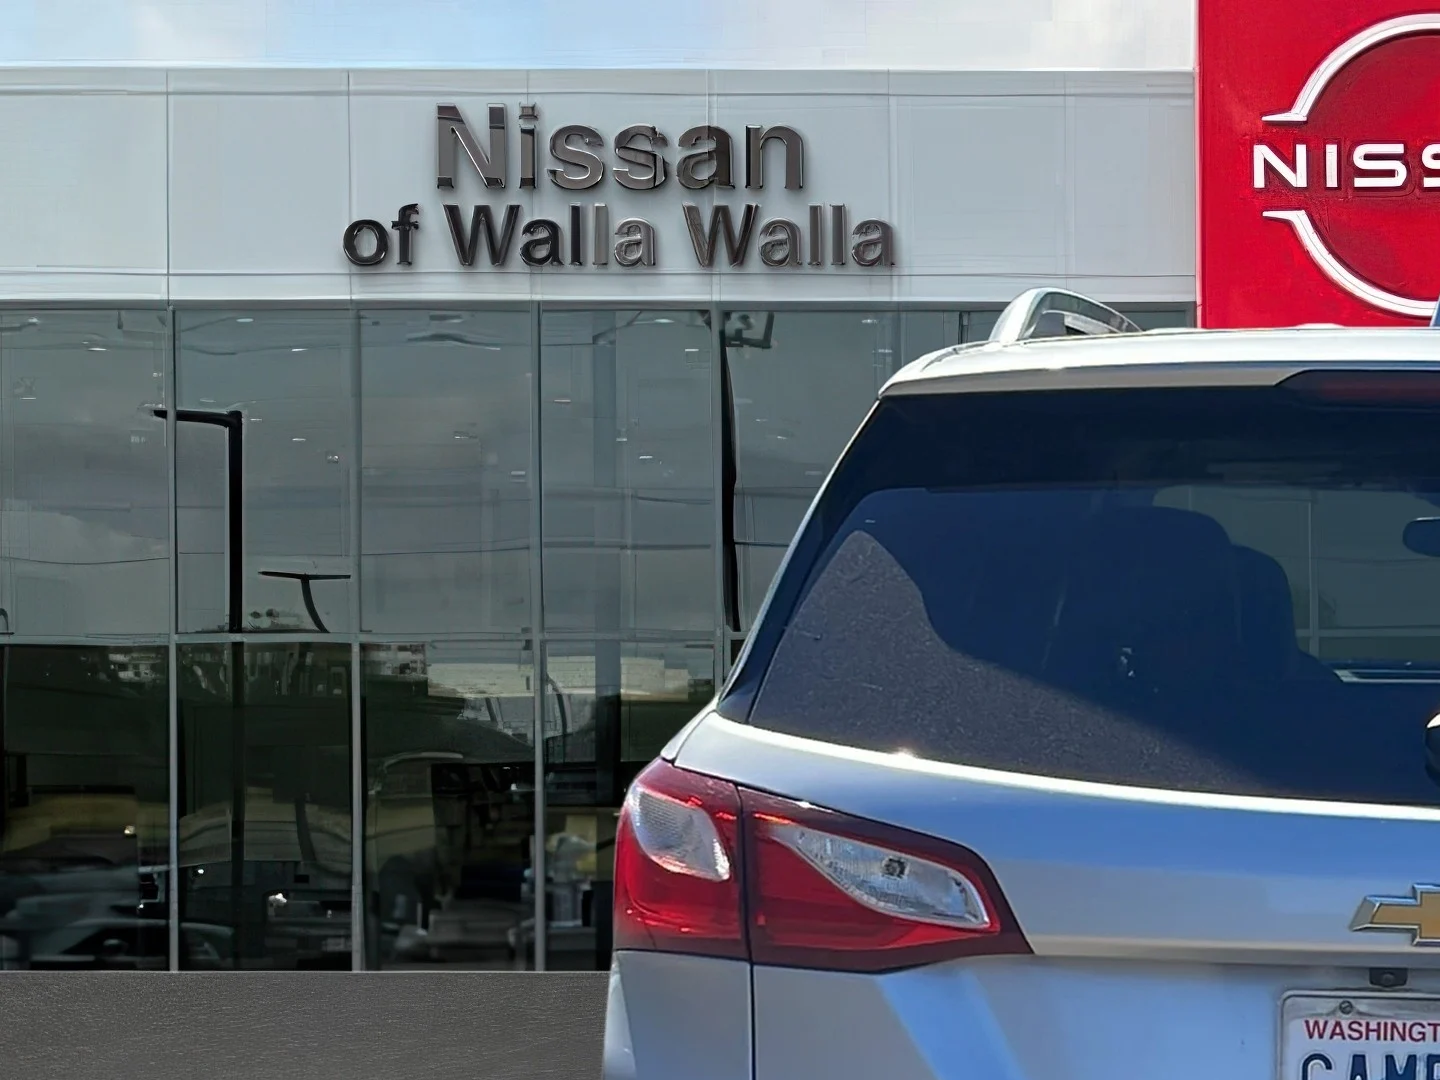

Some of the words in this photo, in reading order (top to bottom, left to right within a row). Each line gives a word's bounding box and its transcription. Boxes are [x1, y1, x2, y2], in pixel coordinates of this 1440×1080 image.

[434, 102, 804, 191] Nissan
[342, 203, 421, 267] of
[443, 203, 656, 267] Walla
[681, 203, 895, 267] Walla
